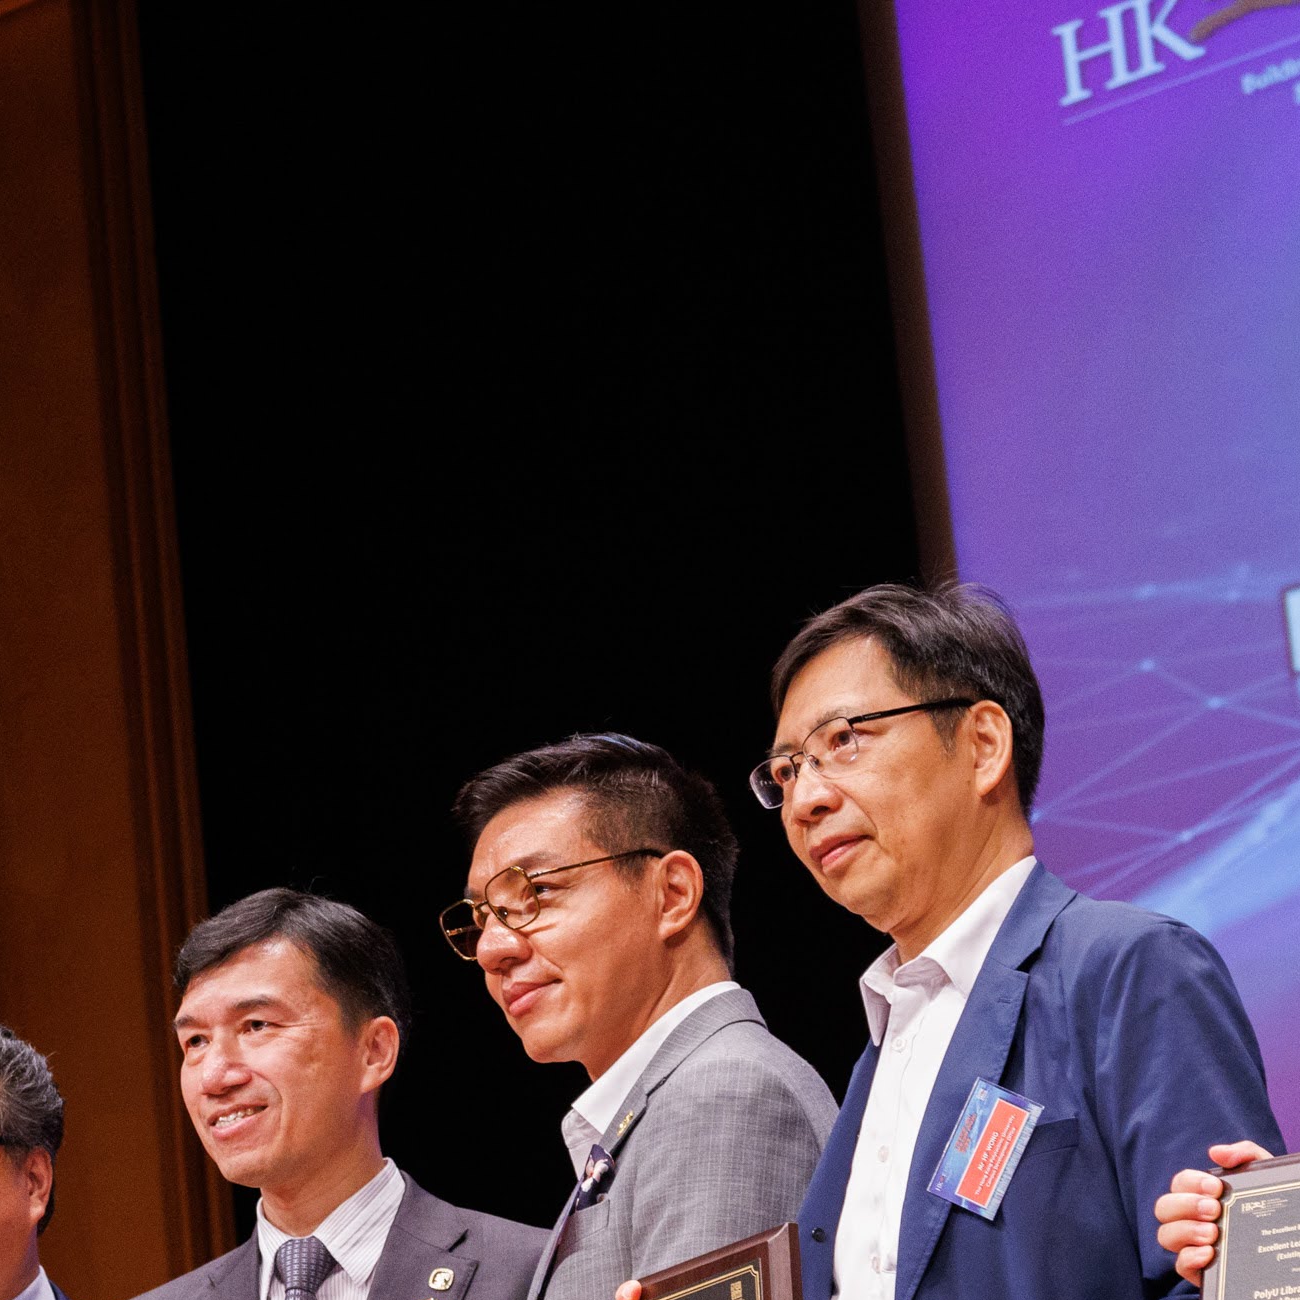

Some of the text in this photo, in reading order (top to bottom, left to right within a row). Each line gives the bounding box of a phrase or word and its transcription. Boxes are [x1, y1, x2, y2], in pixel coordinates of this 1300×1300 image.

[977, 1162, 986, 1171] Mr
[985, 1131, 999, 1152] WONG
[1258, 1241, 1289, 1254] Excellent
[1253, 1287, 1279, 1300] PolyU
